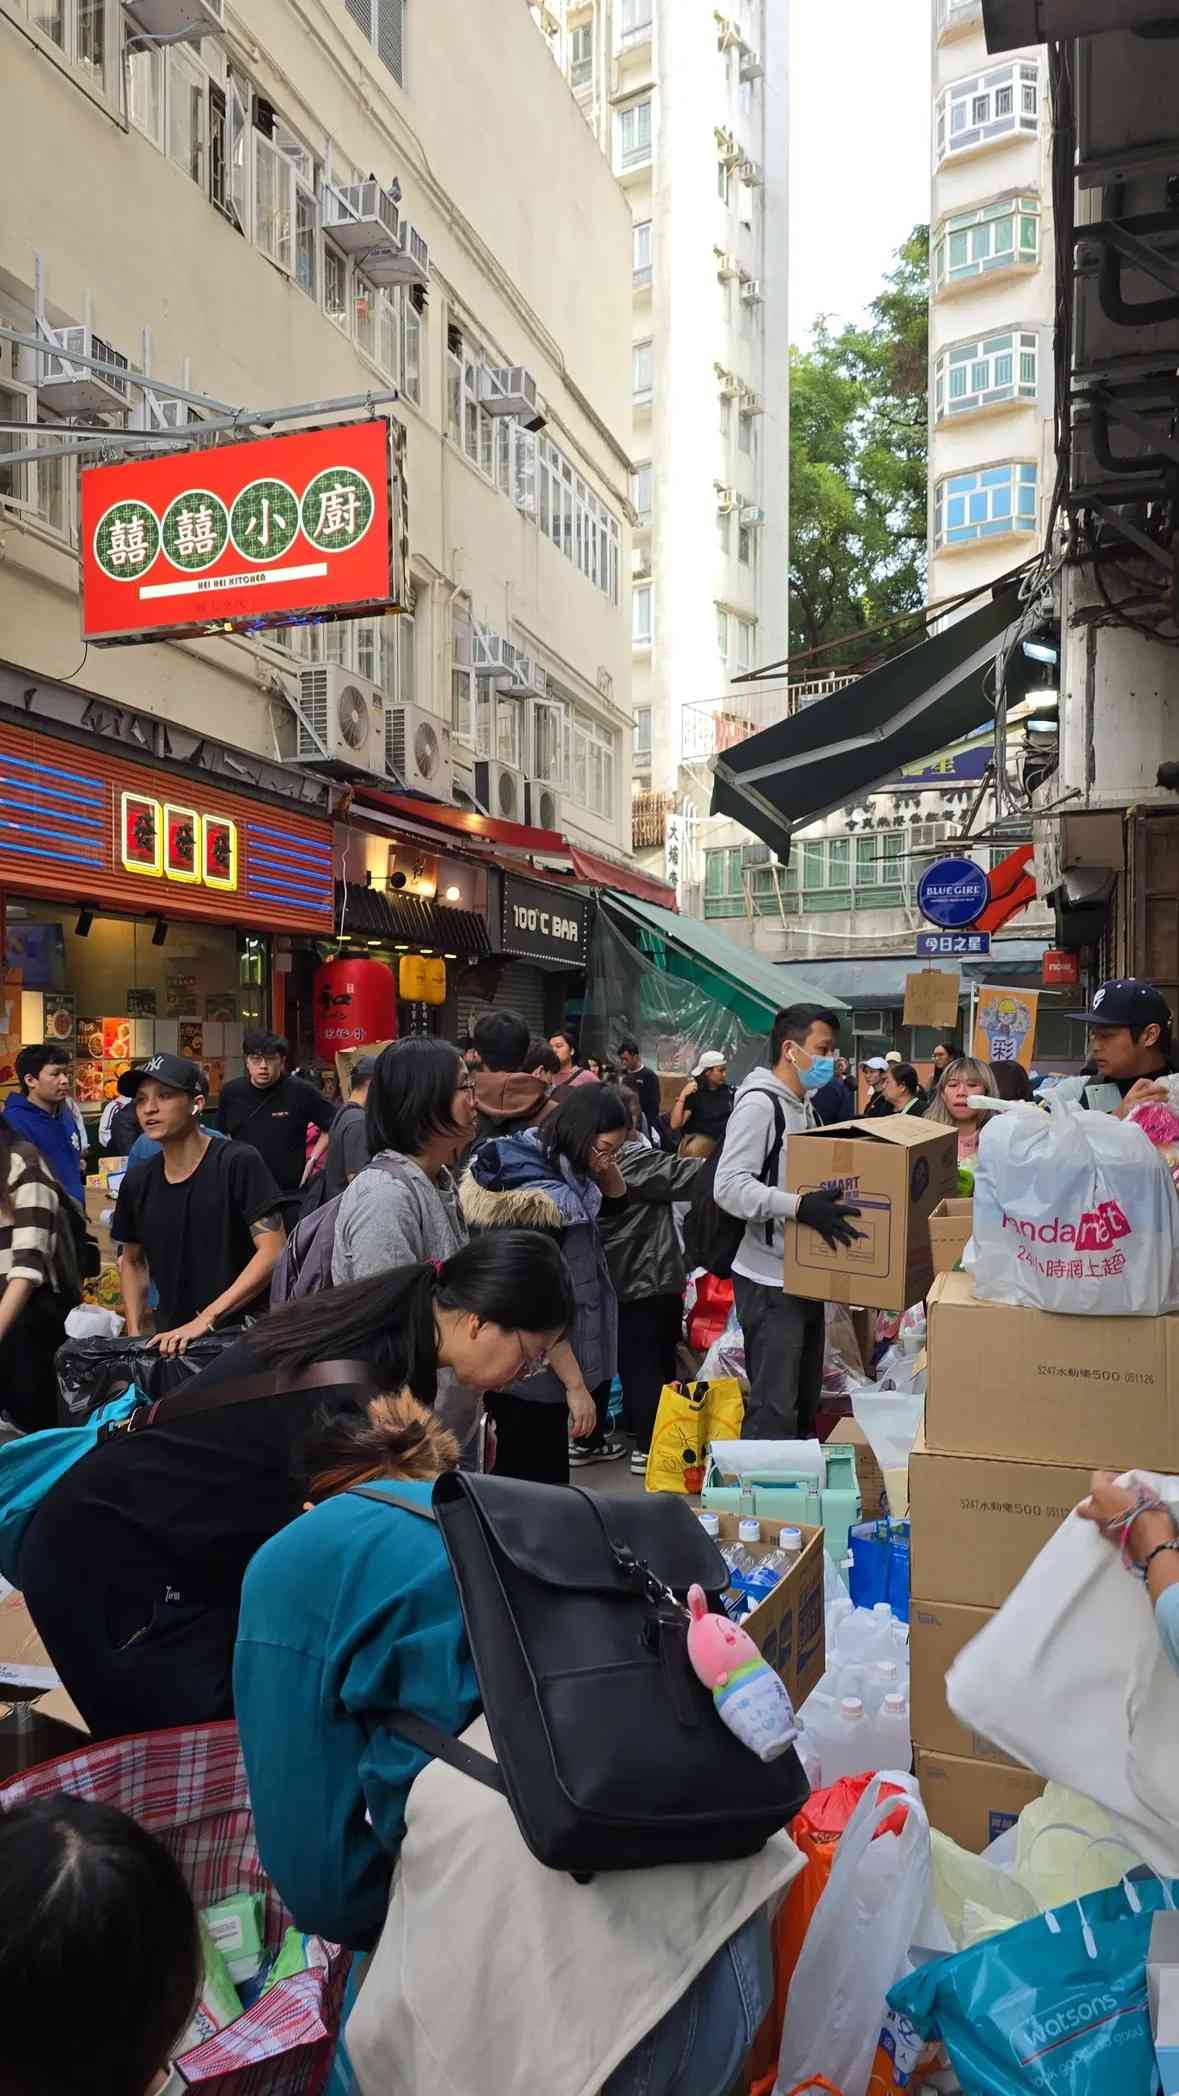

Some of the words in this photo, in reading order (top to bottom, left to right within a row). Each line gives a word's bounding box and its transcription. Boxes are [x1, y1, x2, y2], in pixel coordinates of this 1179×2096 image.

[106, 484, 361, 567] 囍囍小廚
[198, 581, 211, 589] HEI
[213, 579, 226, 588] HEI
[228, 573, 267, 585] KITCHEN
[927, 886, 953, 896] BLUE
[953, 885, 980, 895] GIRL
[551, 916, 579, 942] BAR
[925, 936, 982, 952] 今日之星
[820, 1175, 861, 1192] SMART
